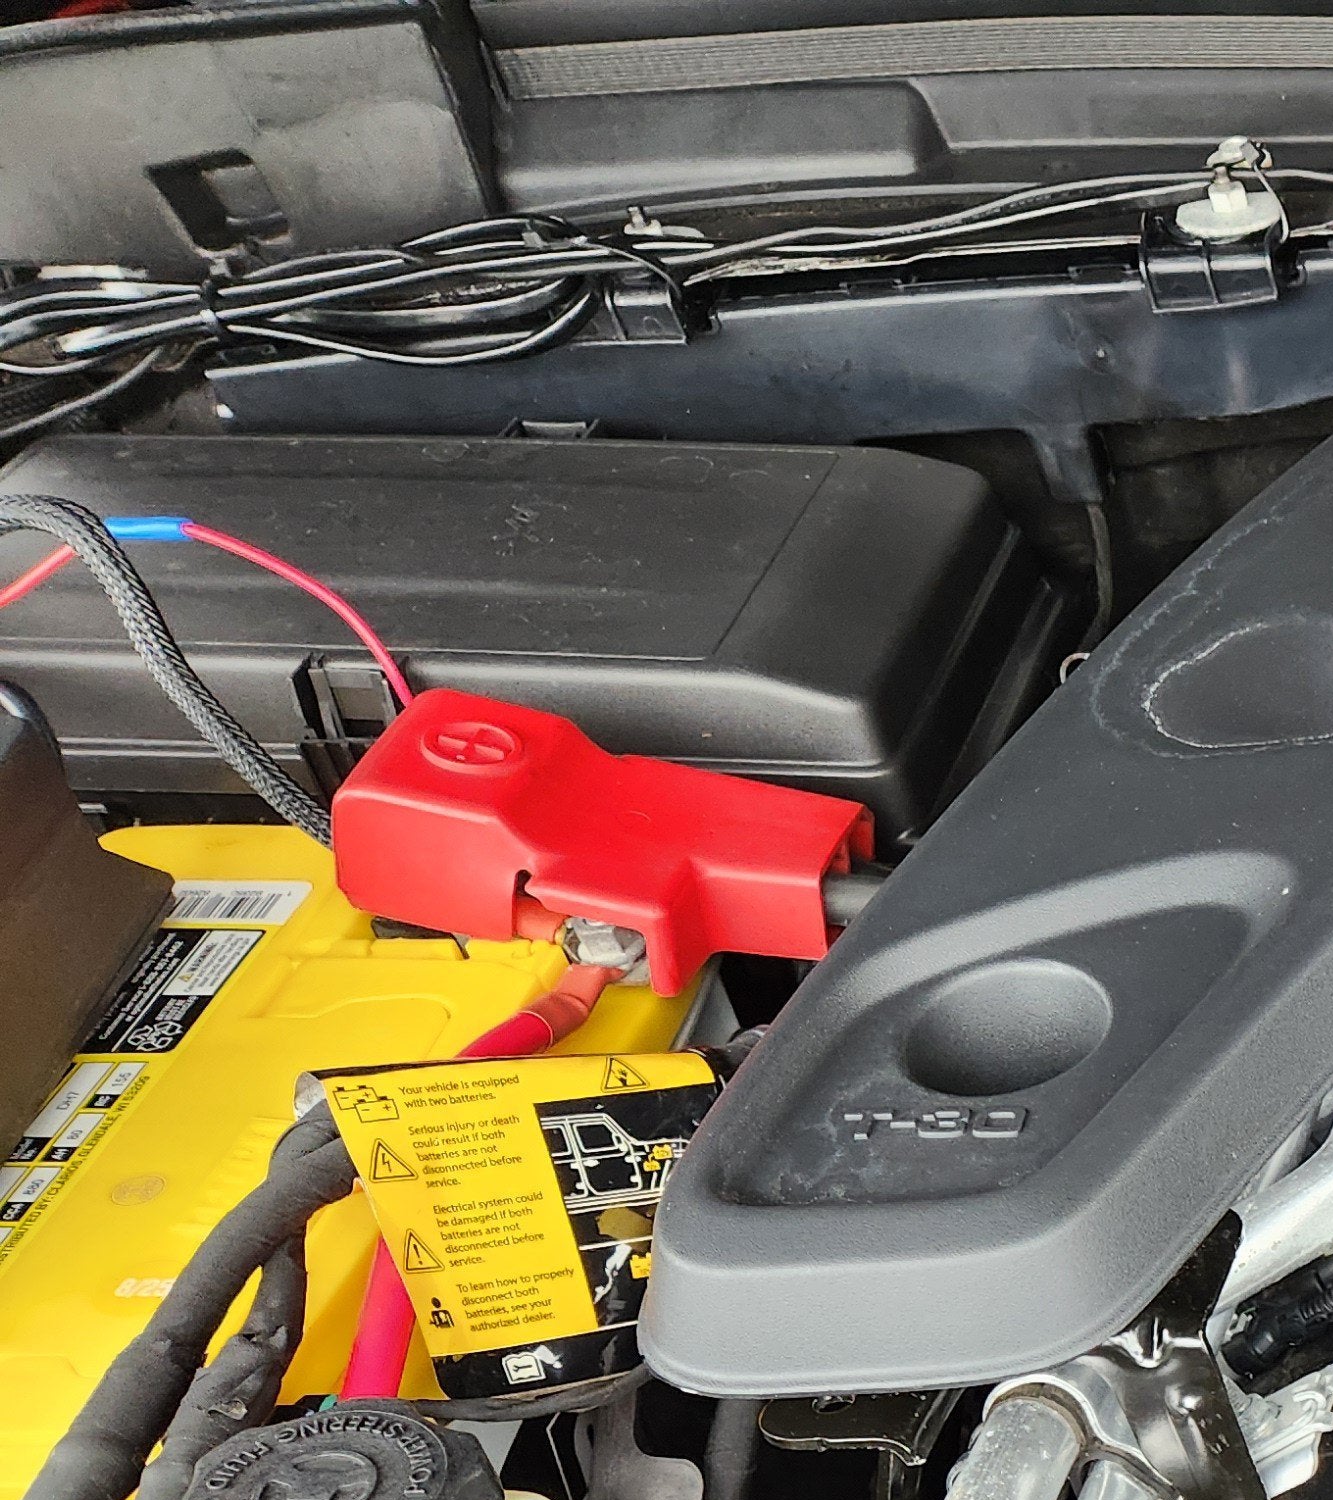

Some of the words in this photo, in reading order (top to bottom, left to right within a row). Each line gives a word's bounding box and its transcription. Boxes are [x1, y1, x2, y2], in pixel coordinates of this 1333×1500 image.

[399, 1085, 421, 1095] Your
[424, 1080, 458, 1093] vehicle
[461, 1081, 469, 1089] is
[472, 1075, 519, 1089] equipped
[404, 1097, 427, 1108] with
[429, 1096, 446, 1106] two
[449, 1091, 496, 1104] batteries.
[408, 1123, 443, 1135] Serious
[446, 1119, 475, 1134] injury
[477, 1119, 488, 1127] or
[491, 1114, 519, 1126] death
[843, 1108, 1027, 1140] T-30
[413, 1136, 439, 1148] could
[442, 1133, 469, 1146] result
[472, 1132, 479, 1142] if
[481, 1129, 506, 1141] both
[418, 1149, 459, 1162] batteries
[462, 1149, 480, 1157] are
[483, 1144, 498, 1154] not
[422, 1159, 486, 1176] disconnected
[489, 1154, 522, 1168] before
[425, 1176, 461, 1188] service.
[433, 1198, 475, 1214] Electrical
[478, 1196, 514, 1211] system
[519, 1191, 543, 1204] could
[437, 1216, 449, 1227] be
[451, 1210, 497, 1227] damaged
[499, 1209, 507, 1219] if
[509, 1205, 533, 1217] both
[0, 1211, 42, 1265] STRIBUTED
[441, 1227, 480, 1240] batteries
[484, 1228, 502, 1236] are
[505, 1223, 520, 1233] not
[445, 1239, 508, 1253] disconnected
[511, 1232, 544, 1246] before
[449, 1255, 485, 1267] service.
[456, 1283, 467, 1293] To
[470, 1278, 493, 1290] learn
[496, 1275, 517, 1287] how
[520, 1274, 531, 1284] to
[534, 1267, 574, 1284] properly
[461, 1290, 511, 1306] disconnect
[515, 1285, 539, 1297] both
[465, 1304, 508, 1319] batteries,
[511, 1303, 527, 1312] see
[530, 1297, 553, 1312] your
[470, 1316, 519, 1333] authorized
[523, 1311, 555, 1325] dealer.
[275, 1414, 404, 1444] STEERING
[205, 1439, 272, 1491] FLUID
[398, 1433, 433, 1496] POWER
